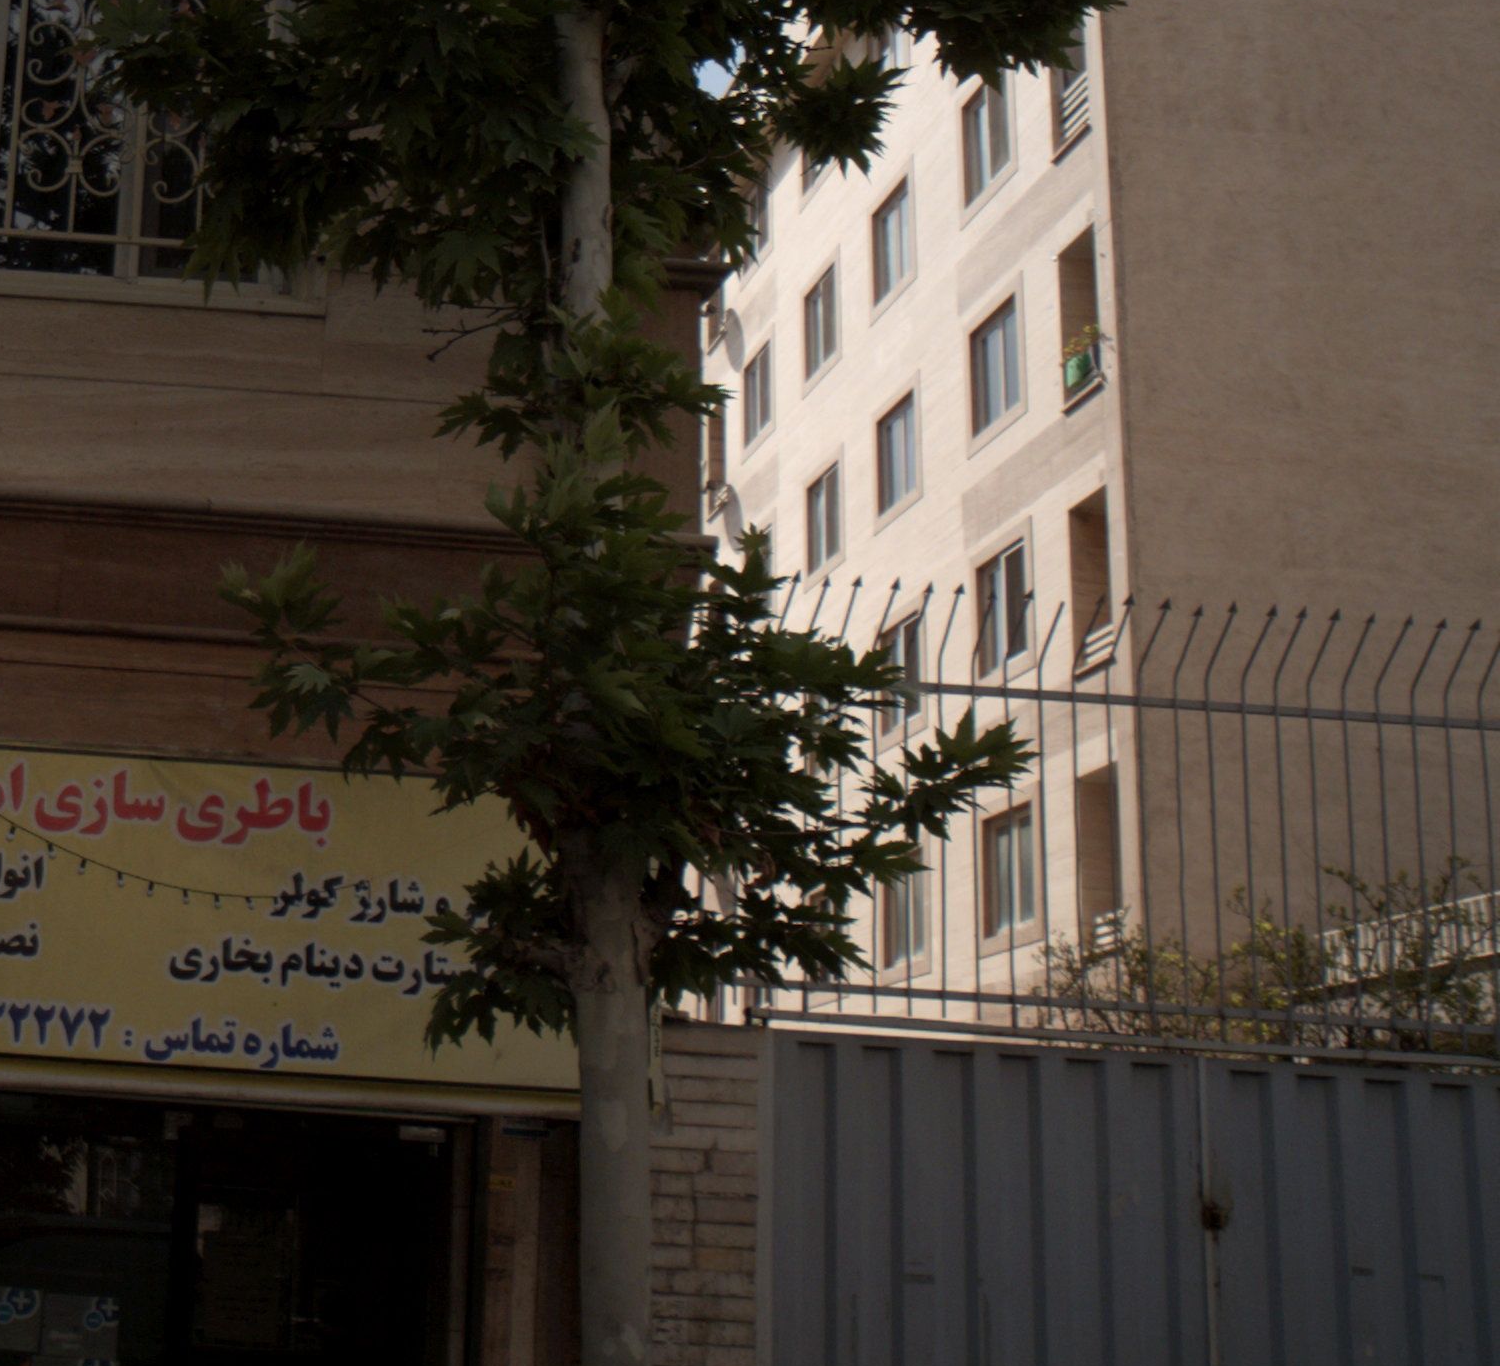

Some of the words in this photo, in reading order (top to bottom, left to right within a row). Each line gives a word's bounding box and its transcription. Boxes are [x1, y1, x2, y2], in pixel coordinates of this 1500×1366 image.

[34, 770, 166, 833] سازی
[177, 778, 330, 848] باطری
[270, 872, 344, 919] کولر
[350, 880, 425, 923] شارژ
[168, 938, 274, 985] بخاری
[280, 942, 364, 988] دینام
[145, 1018, 237, 1062] تماس
[243, 1024, 339, 1069] شماره
